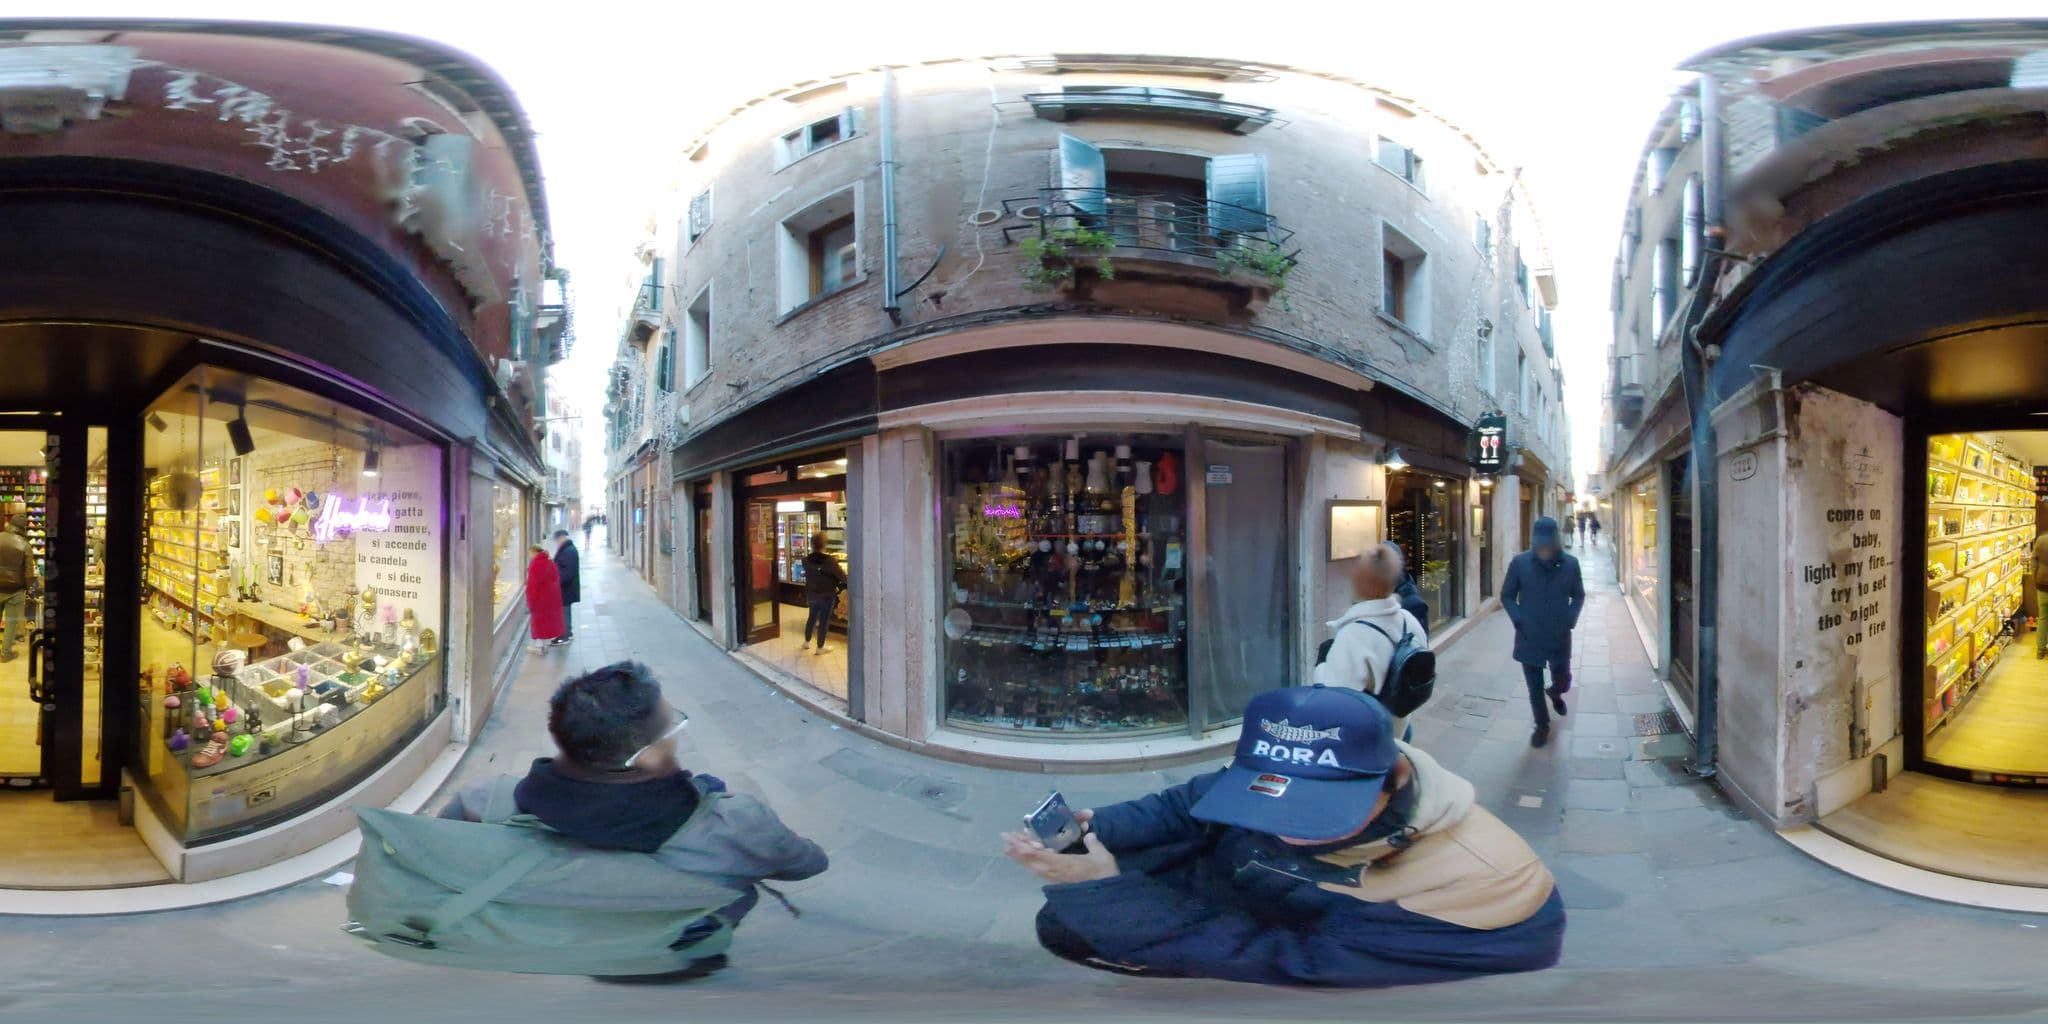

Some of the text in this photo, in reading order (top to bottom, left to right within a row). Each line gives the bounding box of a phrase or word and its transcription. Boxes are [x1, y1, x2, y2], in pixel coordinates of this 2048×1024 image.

[391, 490, 422, 502] piove,
[395, 506, 423, 519] gatta
[1826, 508, 1881, 523] come on
[394, 524, 431, 536] muove,
[371, 538, 427, 550] si accende
[1852, 531, 1881, 548] baby,
[358, 553, 408, 567] la candela
[376, 572, 422, 584] e si dice
[1804, 562, 1837, 584] light
[1844, 561, 1864, 577] my
[1830, 575, 1887, 603] try to set
[1850, 601, 1879, 621] night
[1846, 621, 1886, 646] on fire
[1252, 740, 1340, 767] BORA
